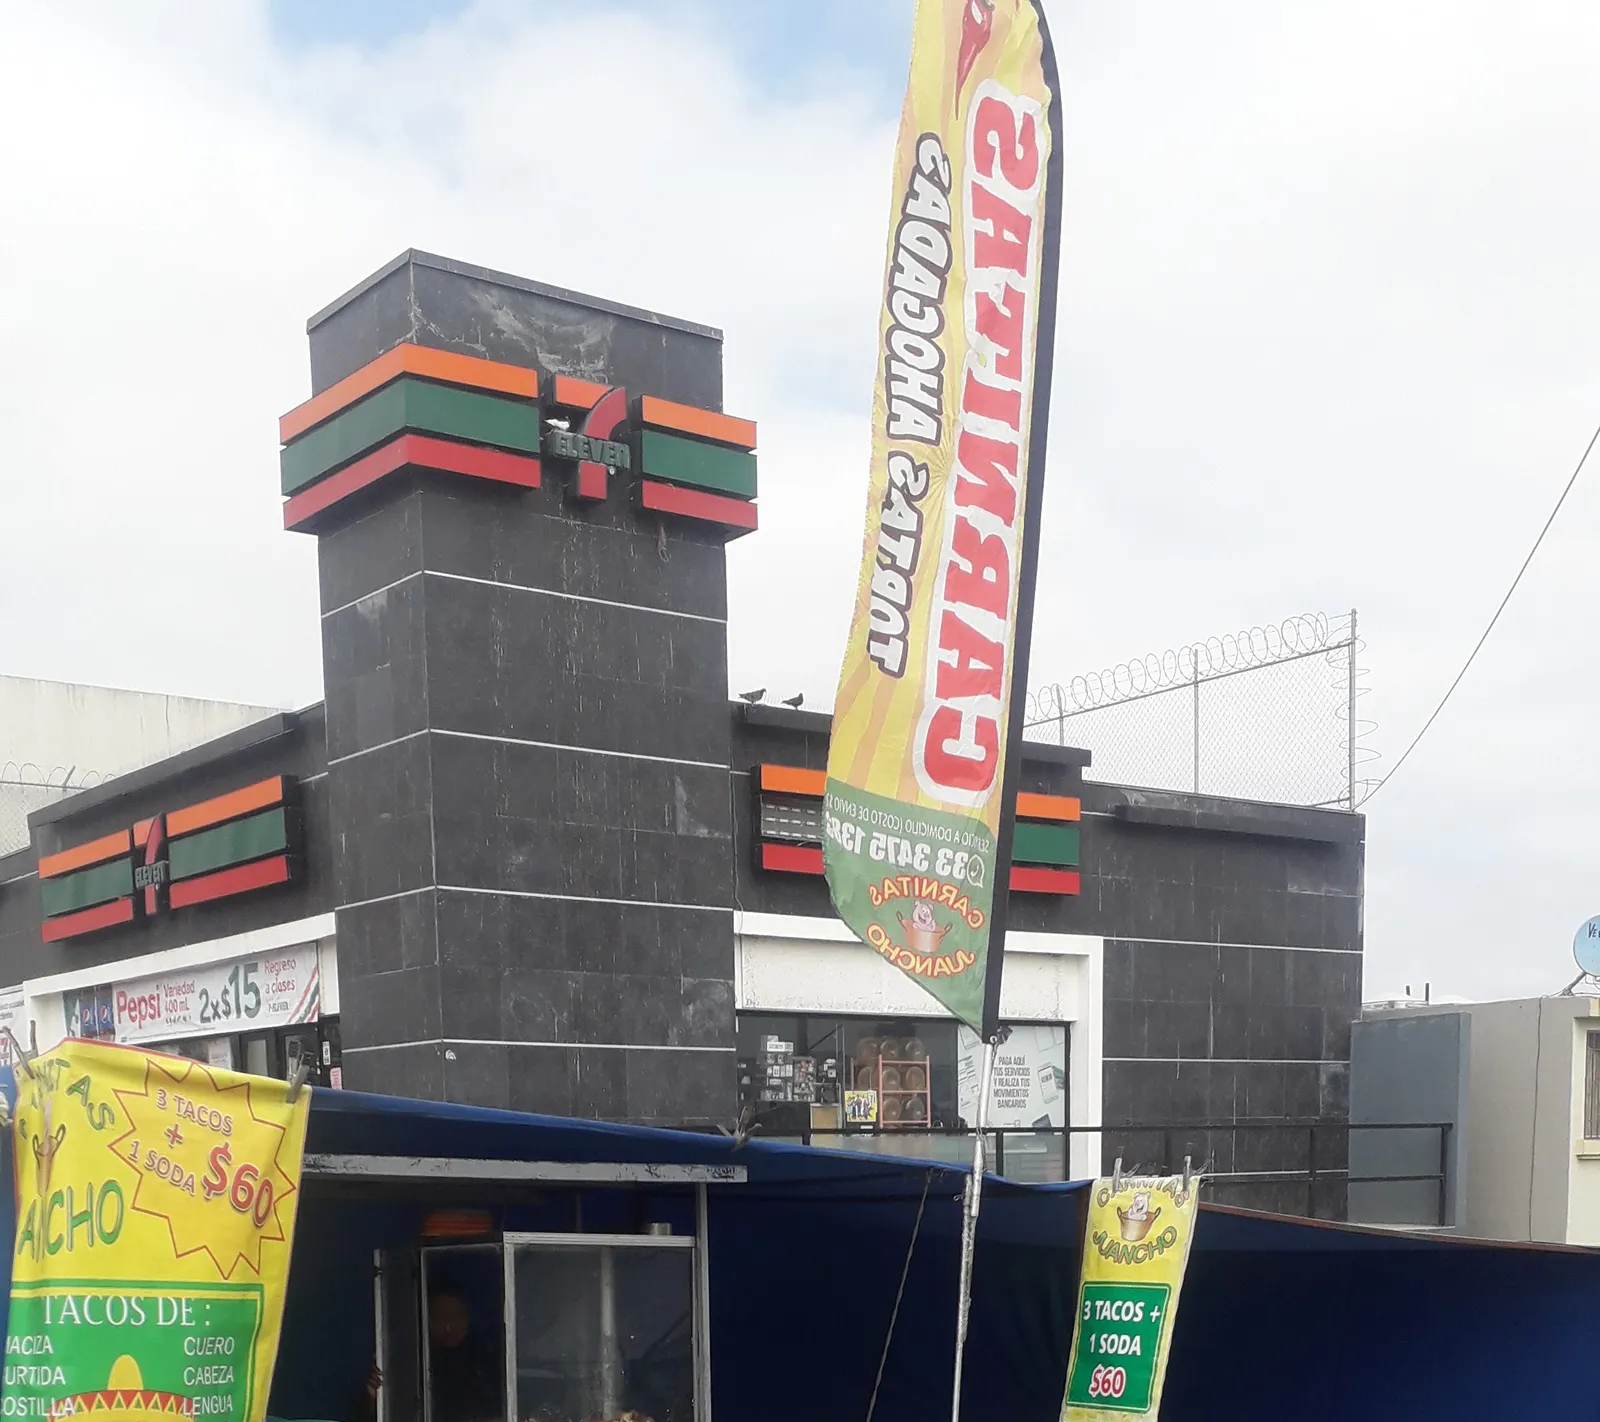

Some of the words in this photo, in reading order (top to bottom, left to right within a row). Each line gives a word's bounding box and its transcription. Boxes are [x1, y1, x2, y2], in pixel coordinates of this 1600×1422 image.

[264, 958, 297, 976] Regreso
[271, 977, 295, 994] clases
[116, 984, 161, 1029] Pepsi
[155, 1088, 168, 1110] 3
[174, 1095, 234, 1135] TACOS
[128, 1140, 139, 1161] 1
[145, 1149, 196, 1195] SODA
[201, 1141, 275, 1228] $60
[1093, 1226, 1178, 1265] JUANCHO
[41, 1294, 146, 1327] TACOS
[156, 1296, 196, 1327] DE
[1083, 1300, 1091, 1321] 3
[1095, 1300, 1145, 1322] TACOS
[183, 1336, 235, 1356] CUERO
[1089, 1334, 1096, 1353] 1
[1099, 1334, 1141, 1356] SODA
[183, 1365, 234, 1386] CABEZA
[1089, 1364, 1127, 1398] $60
[1, 1396, 76, 1416] OSTILLA
[182, 1394, 234, 1416] LENGUA
